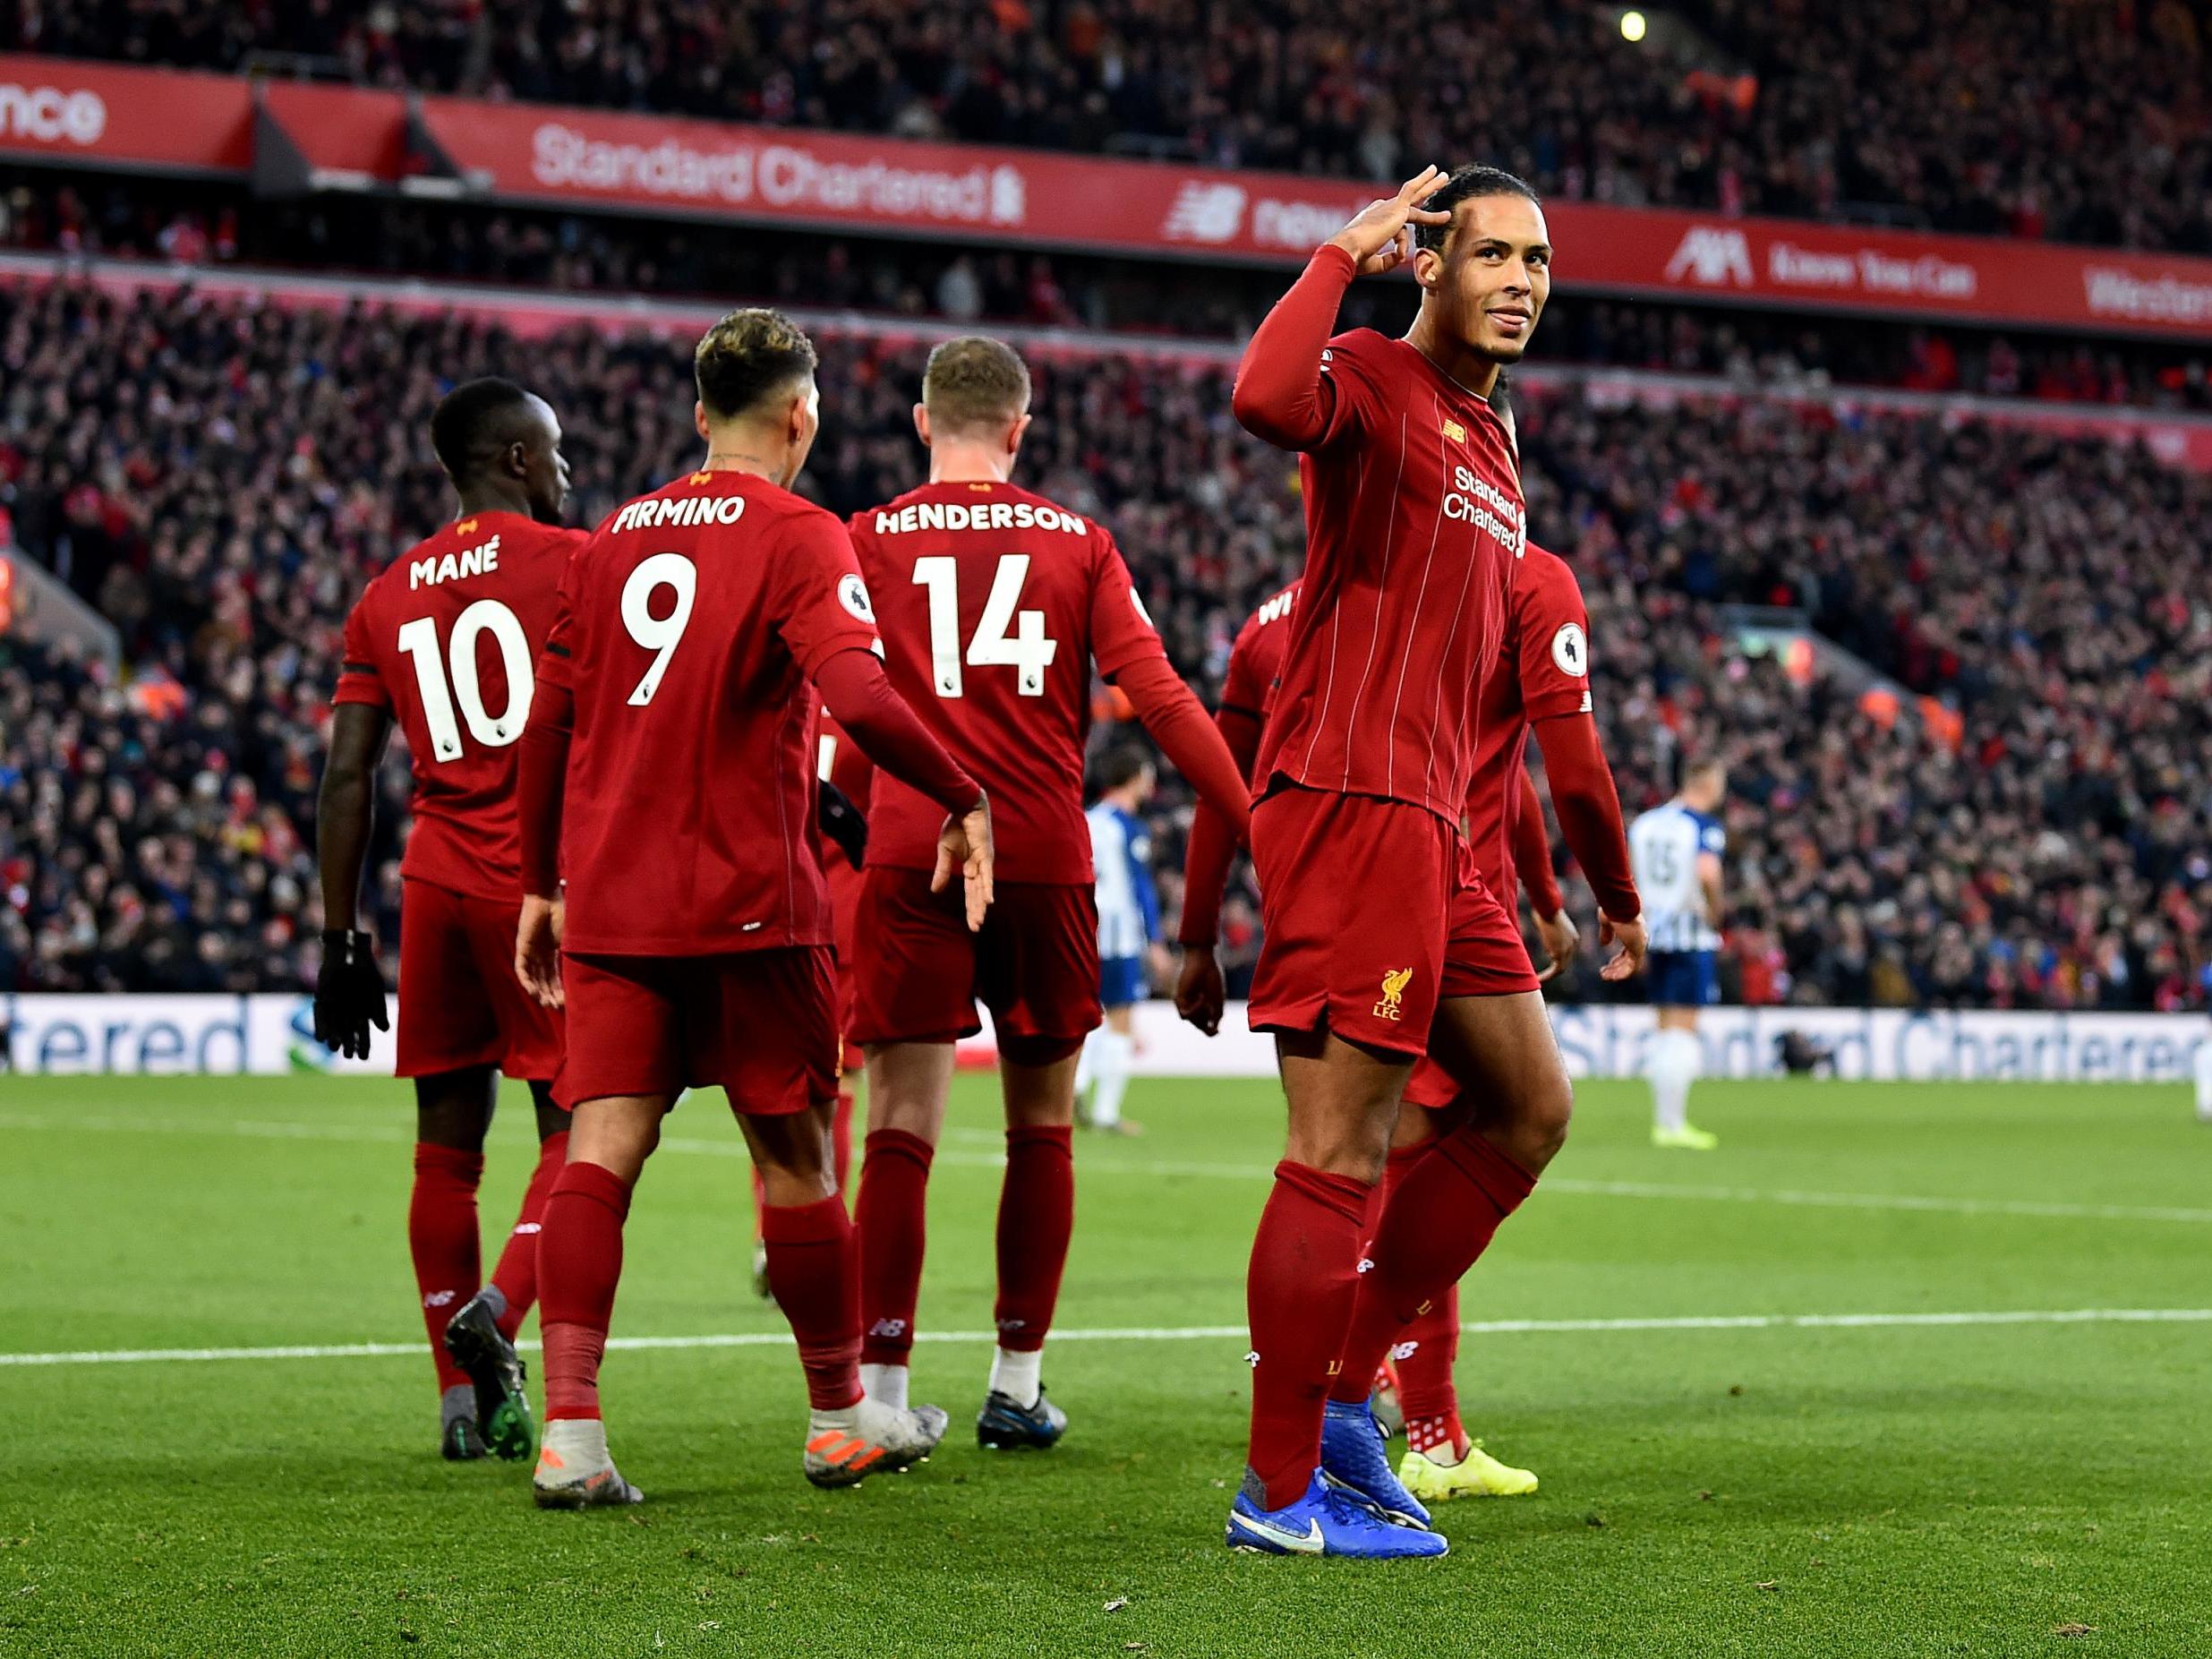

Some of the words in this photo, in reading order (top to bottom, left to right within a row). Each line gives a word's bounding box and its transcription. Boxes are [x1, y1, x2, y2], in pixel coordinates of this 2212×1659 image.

[532, 124, 754, 202] Standard
[757, 146, 989, 220] Chartered
[611, 496, 745, 534] FIRMINO
[875, 502, 1088, 536] HENDERSON
[1443, 493, 1516, 553] Chartered
[1455, 466, 1516, 522] Standard
[409, 534, 500, 590] MANÉ
[620, 552, 697, 706] 9
[912, 554, 1057, 698] 14
[397, 599, 535, 763] 10
[1372, 1005, 1401, 1021] LFC
